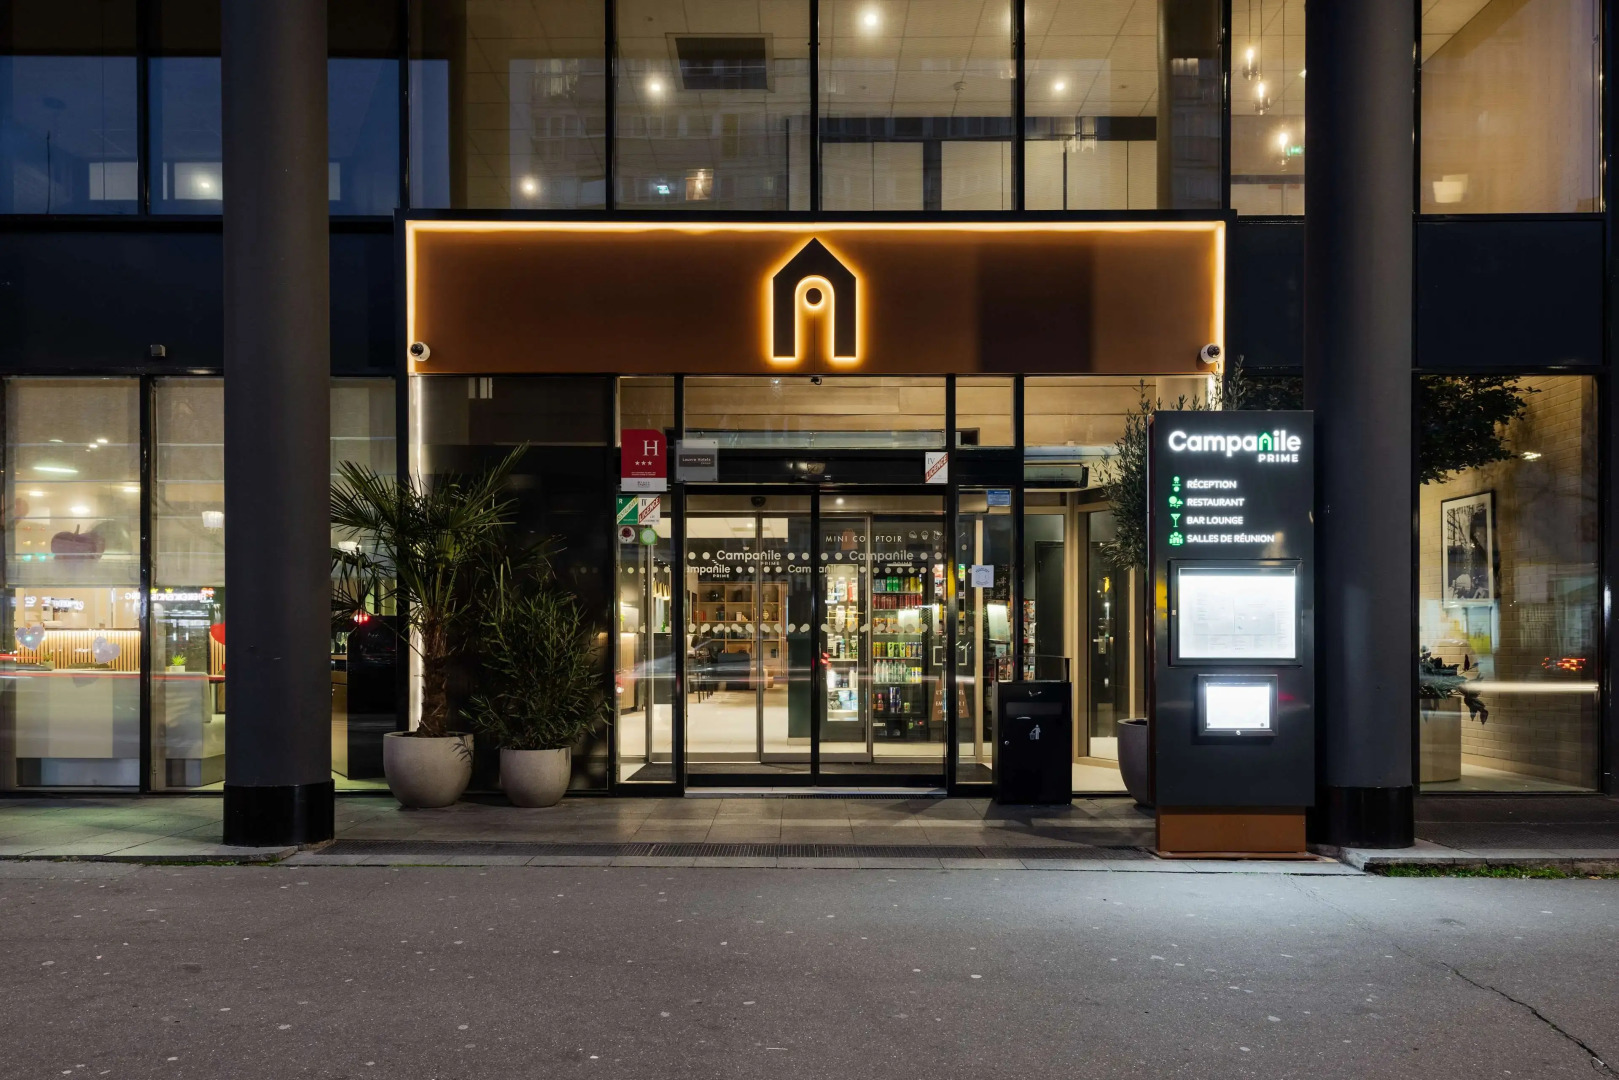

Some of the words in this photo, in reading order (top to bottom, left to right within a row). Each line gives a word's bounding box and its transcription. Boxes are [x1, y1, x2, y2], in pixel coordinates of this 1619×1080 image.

[643, 440, 659, 456] H
[1168, 430, 1301, 457] Campanile
[927, 457, 936, 465] IV
[1258, 454, 1299, 463] PRIME
[1186, 479, 1237, 489] RÉCEPTION
[1186, 498, 1245, 507] RESTAURANT
[639, 496, 660, 522] LICENCE
[1186, 516, 1205, 525] BAR
[1206, 516, 1244, 525] LOUNGE
[825, 535, 848, 543] MINI
[852, 535, 902, 543] COPTOIR
[1186, 534, 1219, 543] SALLES
[1220, 534, 1233, 543] DE
[1234, 533, 1275, 543] RÉUNION
[716, 550, 781, 563] Campanile
